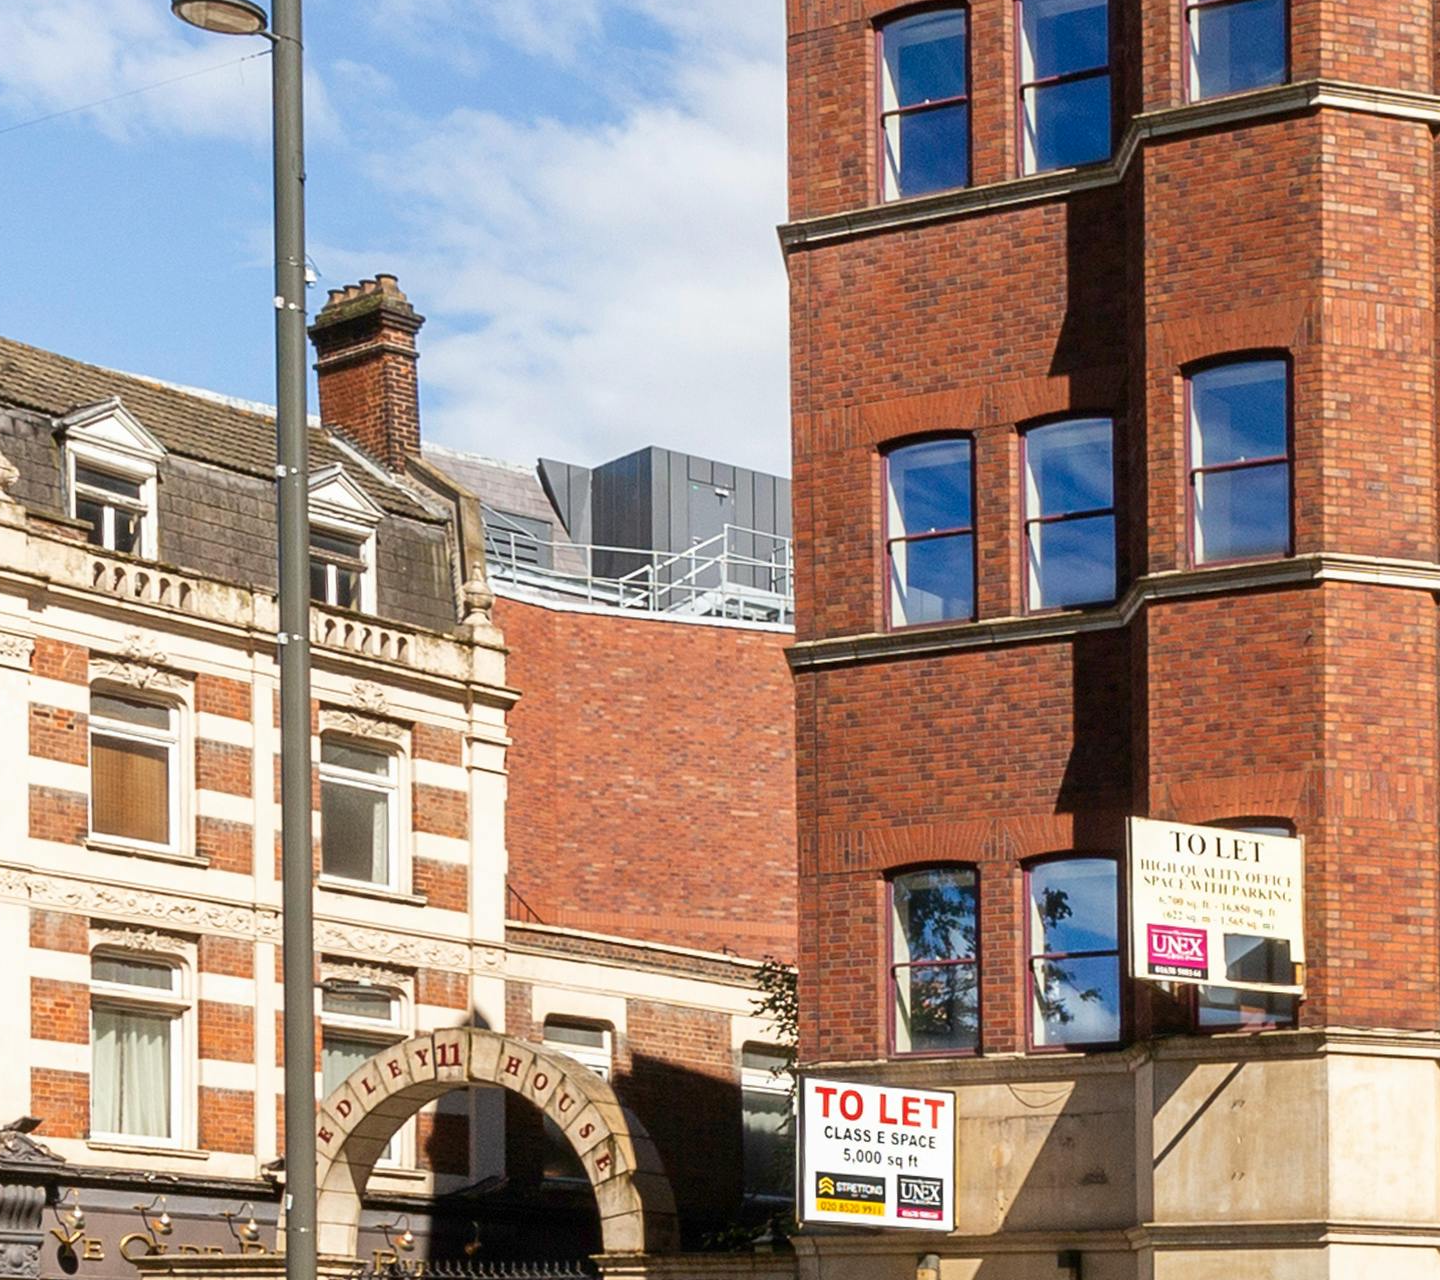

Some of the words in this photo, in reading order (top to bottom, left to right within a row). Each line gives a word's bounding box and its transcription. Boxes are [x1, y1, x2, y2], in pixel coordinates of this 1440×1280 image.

[1169, 830, 1207, 856] TO
[1216, 837, 1264, 863] LET
[1140, 858, 1177, 873] HIGH
[1181, 865, 1240, 881] QUALITY
[1246, 871, 1292, 888] OFFICE
[1143, 875, 1184, 889] SPACE
[1190, 880, 1228, 895] WITH
[1232, 885, 1292, 903] PARKING
[1151, 935, 1203, 957] UNEX
[436, 1042, 462, 1067] 11
[316, 1049, 429, 1167] EDLEY
[504, 1054, 611, 1172] HOUSE
[815, 1086, 864, 1121] TO
[880, 1093, 945, 1129] LET
[824, 1125, 872, 1143] CLASS
[877, 1131, 885, 1144] E
[891, 1132, 936, 1149] SPACE
[843, 1148, 882, 1164] 5,000
[887, 1155, 903, 1169] sq
[908, 1154, 918, 1167] ft
[900, 1183, 940, 1201] UNEX
[820, 1202, 836, 1212] 020
